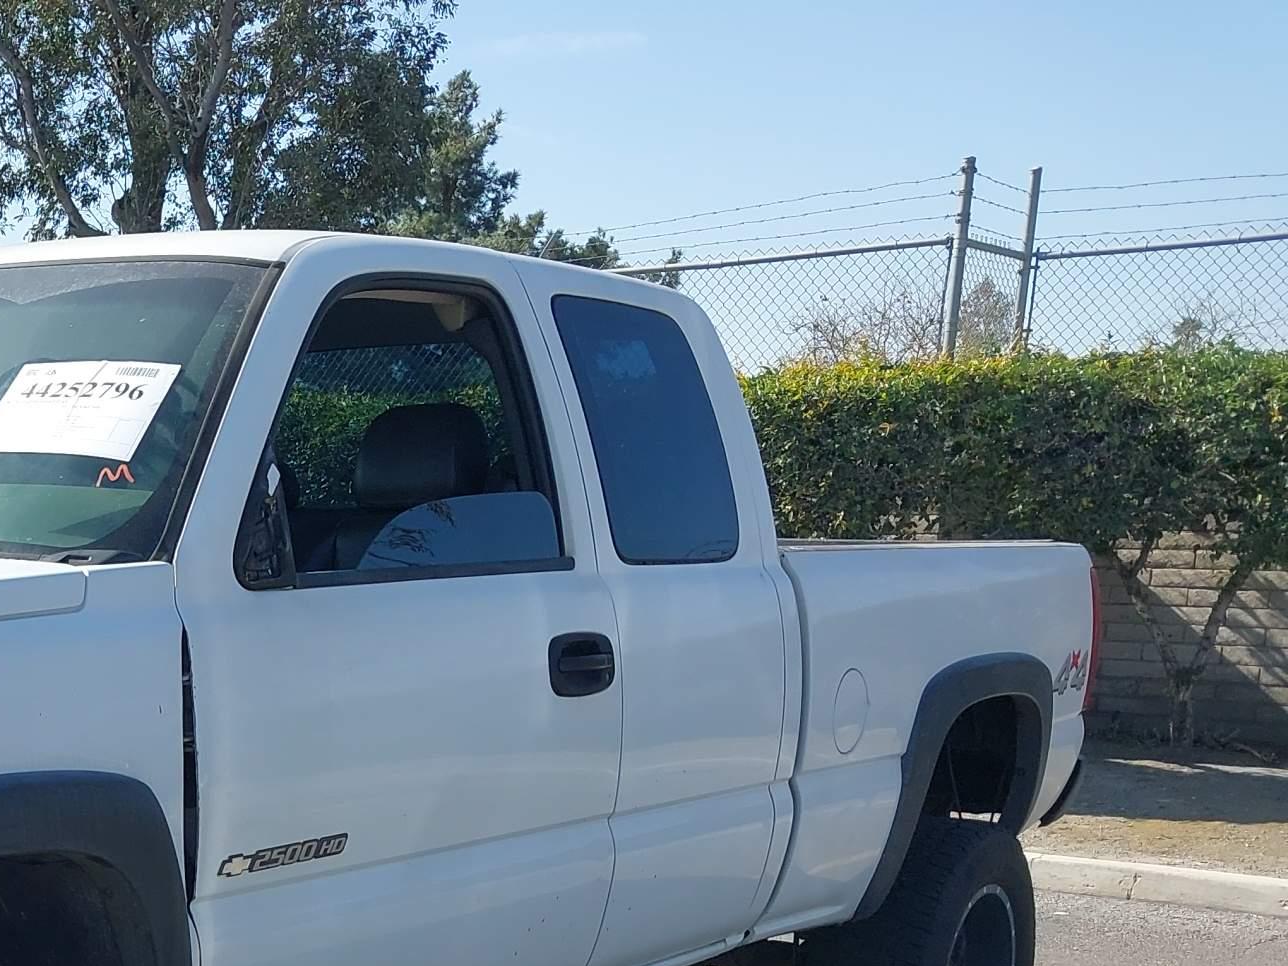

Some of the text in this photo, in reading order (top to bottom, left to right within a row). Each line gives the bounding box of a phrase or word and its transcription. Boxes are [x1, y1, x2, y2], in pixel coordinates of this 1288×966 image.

[20, 381, 149, 401] 44252796
[252, 836, 347, 871] 2500 HD
